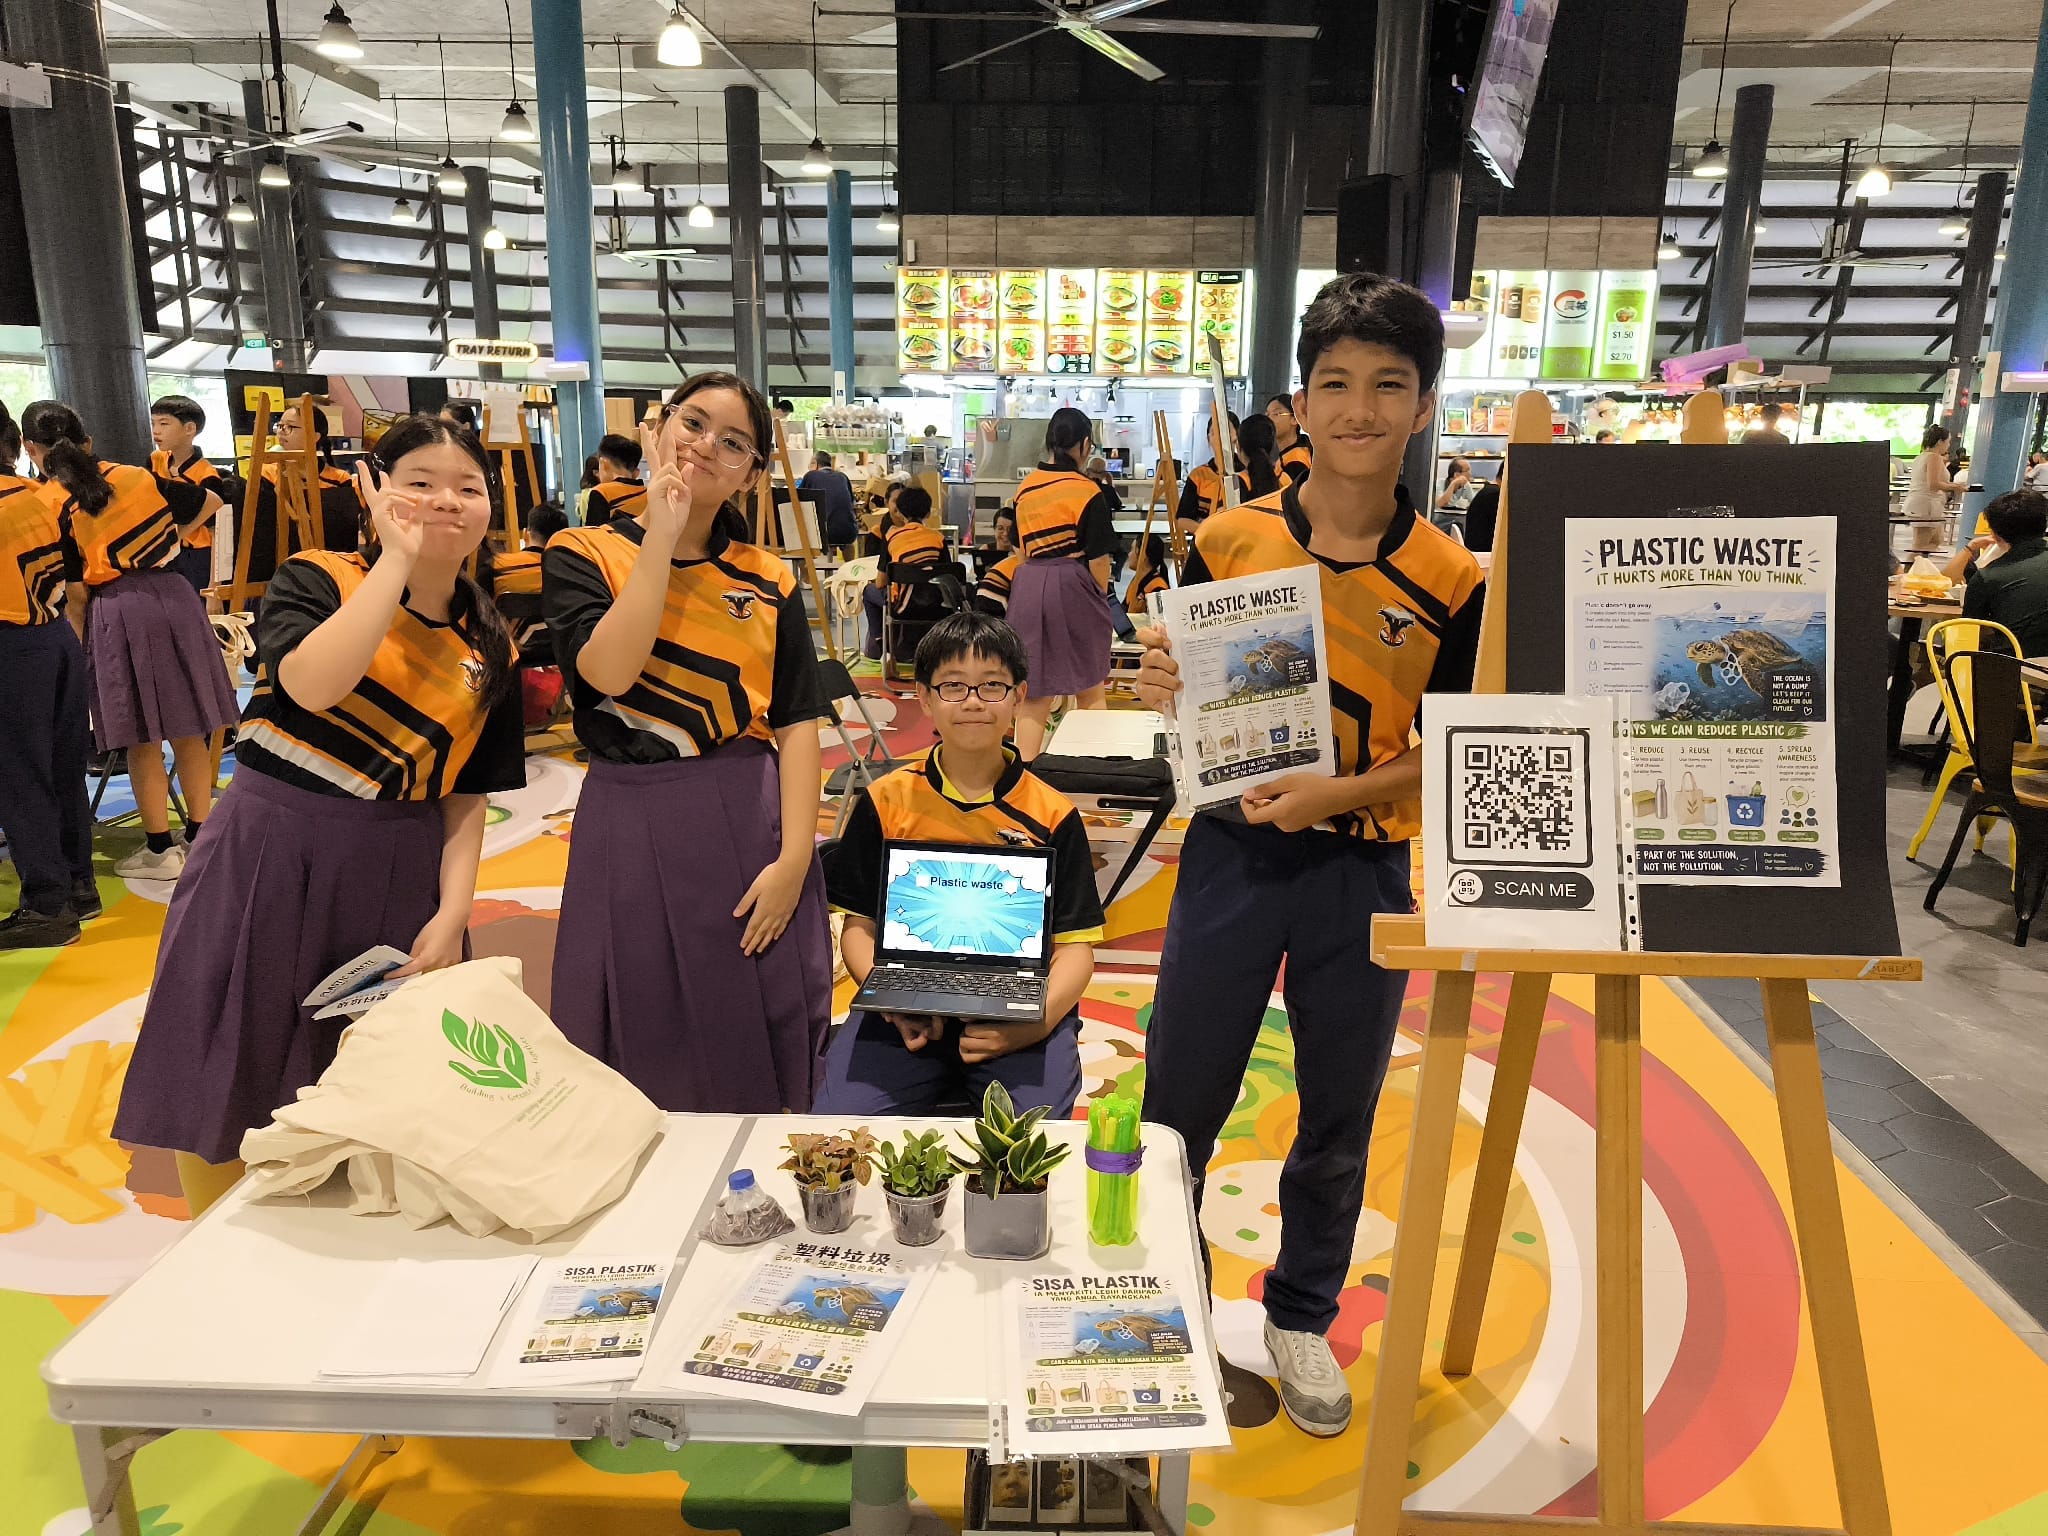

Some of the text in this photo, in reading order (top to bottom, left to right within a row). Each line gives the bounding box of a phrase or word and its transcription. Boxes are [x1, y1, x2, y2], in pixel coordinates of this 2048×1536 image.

[1612, 330, 1634, 338] $1.50
[456, 344, 531, 358] TRAY RETURN
[1610, 352, 1632, 361] $2.70
[1600, 537, 1803, 568] PLASTIC WASTE
[1596, 568, 1807, 586] IT HURTS MORE THAN YOU THINK.
[1190, 586, 1298, 621] PLASTIC WASTE
[1200, 616, 1222, 629] HURTS
[1224, 613, 1242, 623] MORE
[1245, 610, 1263, 619] THAN
[1209, 701, 1226, 709] WAYS
[1238, 696, 1250, 704] CAN
[1252, 692, 1273, 702] REDUCE
[1274, 687, 1297, 698] PLASTIC
[1632, 723, 1785, 736] YS WE CAN REDUCE PLASTIC
[1644, 850, 1664, 860] PART
[1667, 850, 1677, 859] OF
[1680, 850, 1695, 859] THE
[1698, 850, 1739, 860] SOLUTION,
[1644, 862, 1725, 871] NOT THE POLLUTION.
[930, 876, 1003, 890] Plastic waste
[1494, 881, 1577, 897] SCAN ME
[459, 1082, 495, 1102] Building
[792, 1242, 891, 1267] 塑料垃圾
[565, 1264, 656, 1276] SISA PLASTIK
[1032, 1276, 1160, 1290] SISA PLASTIK
